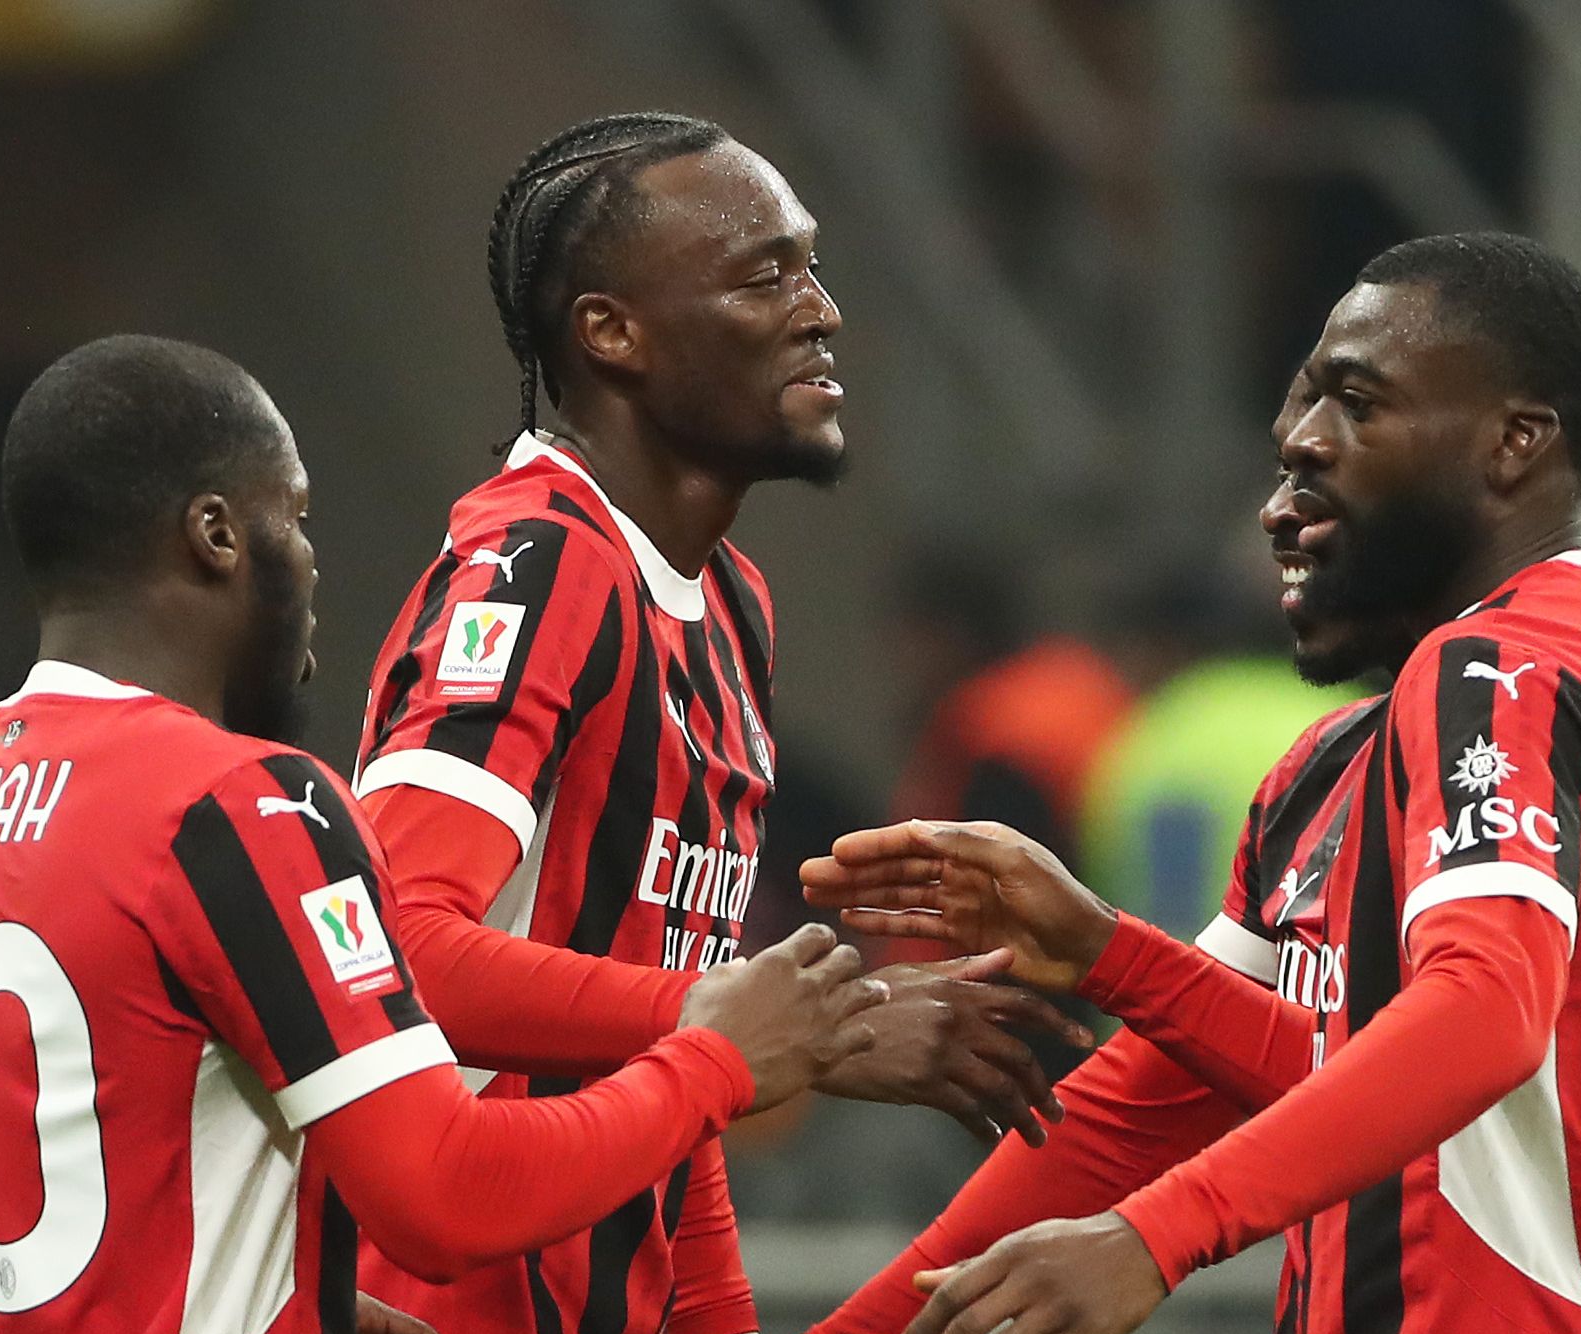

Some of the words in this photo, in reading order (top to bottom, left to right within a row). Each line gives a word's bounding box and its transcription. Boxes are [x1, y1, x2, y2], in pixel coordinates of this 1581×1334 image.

[444, 665, 472, 674] COPPA
[475, 666, 501, 675] ITALIA
[1426, 796, 1563, 868] MSC
[638, 816, 759, 923] Emirat
